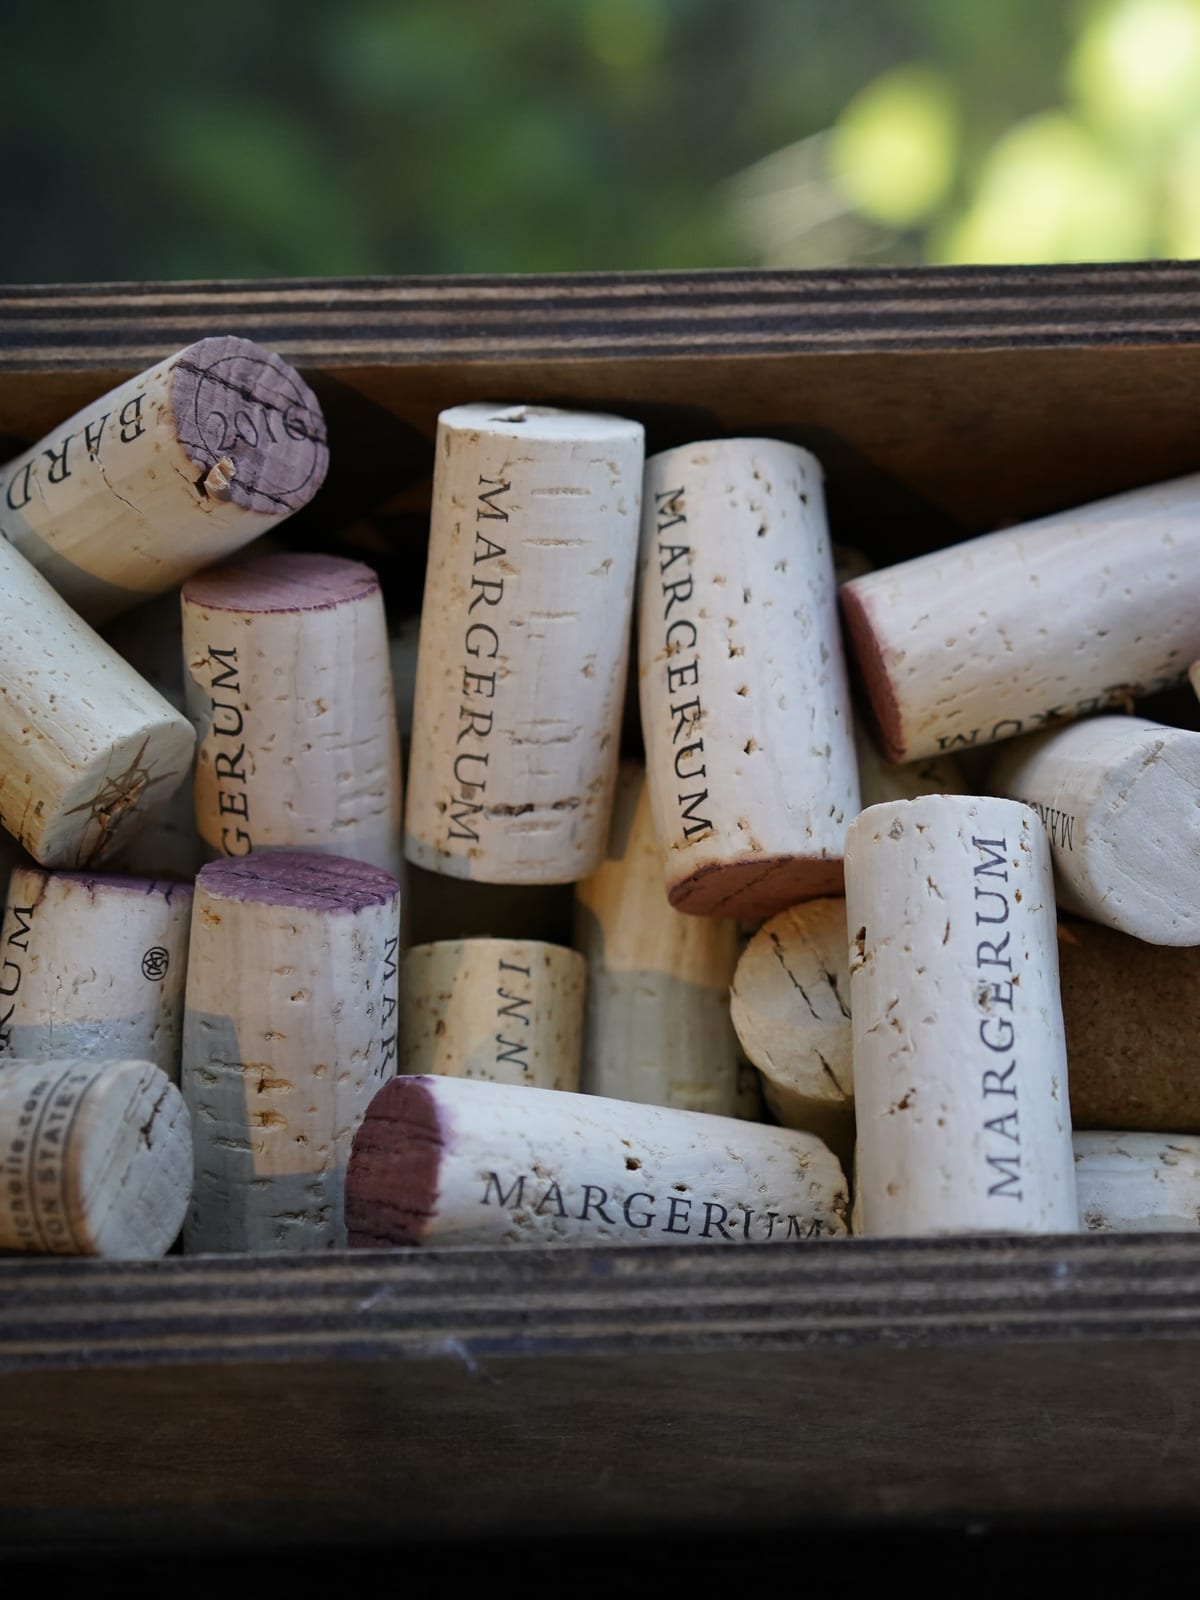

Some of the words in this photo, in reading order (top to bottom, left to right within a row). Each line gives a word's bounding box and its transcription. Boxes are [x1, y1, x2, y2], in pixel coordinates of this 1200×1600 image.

[207, 404, 307, 451] 2016
[208, 645, 253, 858] GERUM
[447, 474, 512, 843] MARGERUM
[655, 486, 714, 841] MARGERUM
[972, 835, 1023, 1202] MARGERUM
[480, 1172, 825, 1241] MARGERUM
